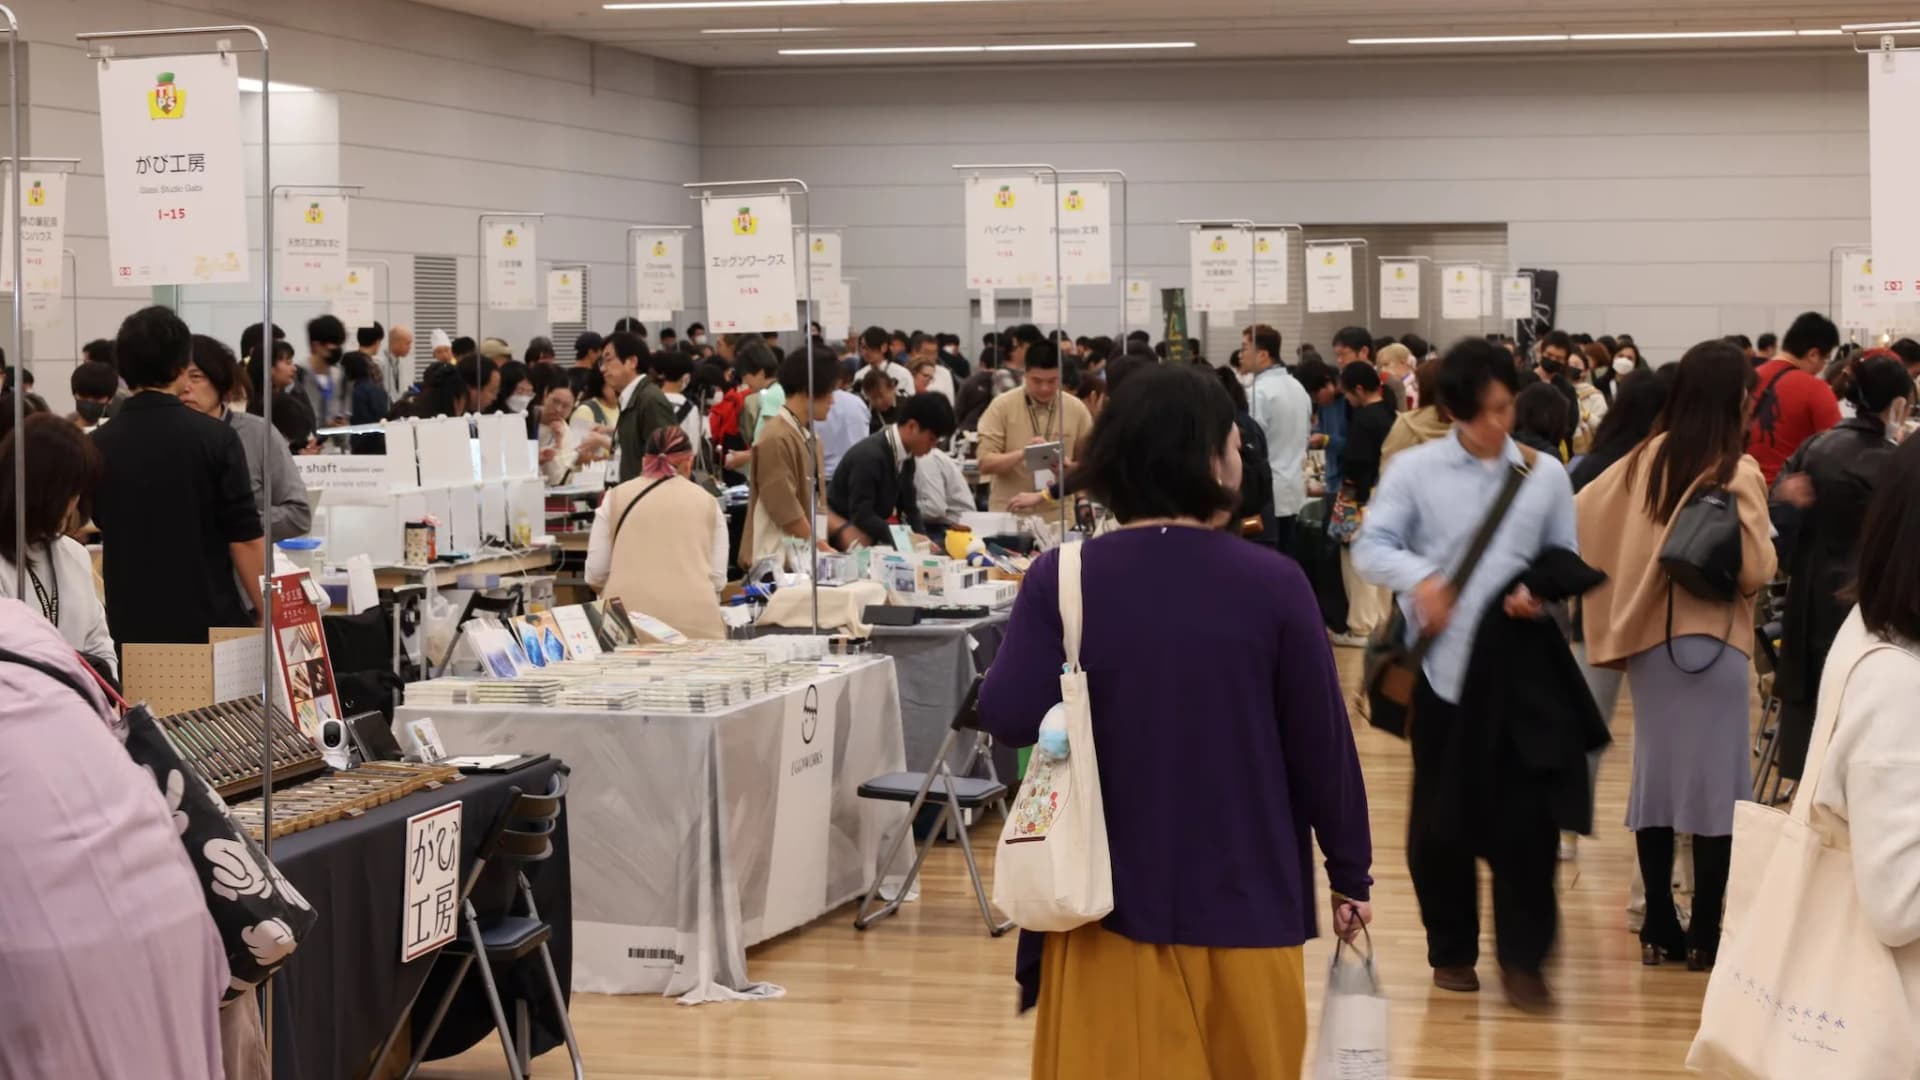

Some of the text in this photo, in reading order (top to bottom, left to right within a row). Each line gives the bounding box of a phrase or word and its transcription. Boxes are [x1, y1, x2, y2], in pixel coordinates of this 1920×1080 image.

[136, 153, 206, 174] がび工房
[306, 463, 337, 473] shaft
